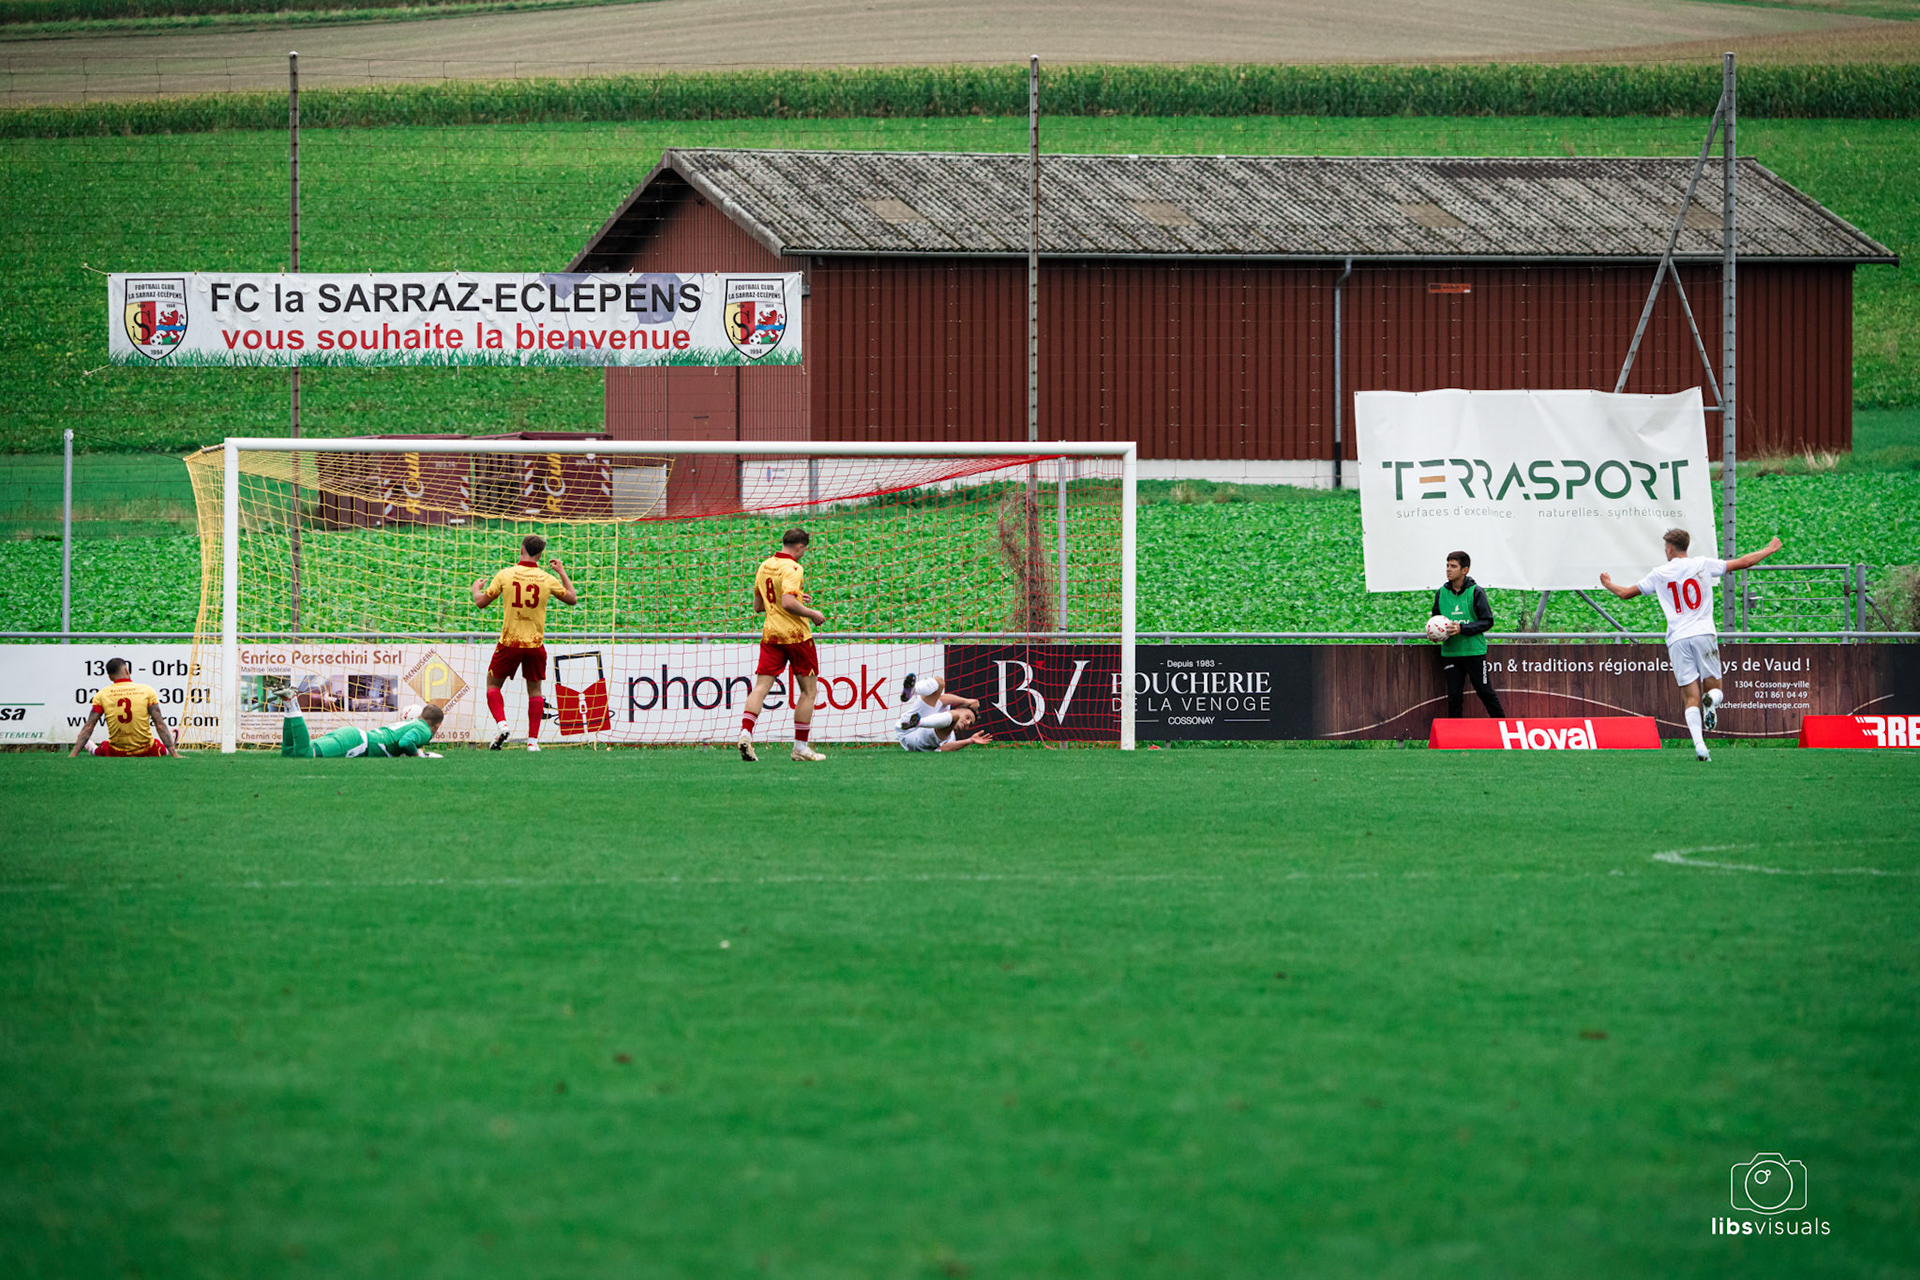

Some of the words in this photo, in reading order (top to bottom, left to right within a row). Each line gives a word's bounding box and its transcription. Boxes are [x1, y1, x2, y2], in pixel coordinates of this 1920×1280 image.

[211, 283, 260, 312] FC
[275, 283, 304, 312] la
[318, 282, 701, 312] SARRAZ-ECLEPENS
[222, 330, 305, 350] vous
[317, 322, 463, 350] souhaite
[477, 322, 503, 350] la
[516, 322, 690, 350] bienvenue
[1382, 459, 1689, 501] TERRASPORT
[1396, 507, 1449, 518] surfaces
[511, 581, 540, 609] 13
[765, 578, 776, 603] 8
[1667, 578, 1702, 614] 10
[241, 651, 286, 664] Enrico
[292, 651, 368, 664] Persechini
[1167, 660, 1194, 668] Depuis
[1507, 659, 1517, 672] &
[1522, 658, 1594, 672] traditions
[1742, 657, 1760, 671] de
[1764, 657, 1801, 671] Vaud
[1755, 681, 1810, 690] Cossonay-ville
[159, 688, 184, 704] 30
[443, 685, 471, 715] GENCEMENT
[1755, 691, 1768, 699] 021
[1771, 691, 1784, 699] 861
[1787, 691, 1796, 699] 04
[1798, 691, 1808, 699] 49
[117, 697, 132, 724] 3
[1149, 697, 1172, 711] LA
[1181, 697, 1271, 711] VENOGE
[1168, 717, 1215, 725] COSSONAY
[241, 732, 270, 740] Chemin
[448, 731, 458, 739] 10
[460, 731, 470, 739] 59
[1498, 720, 1598, 750] Hoval
